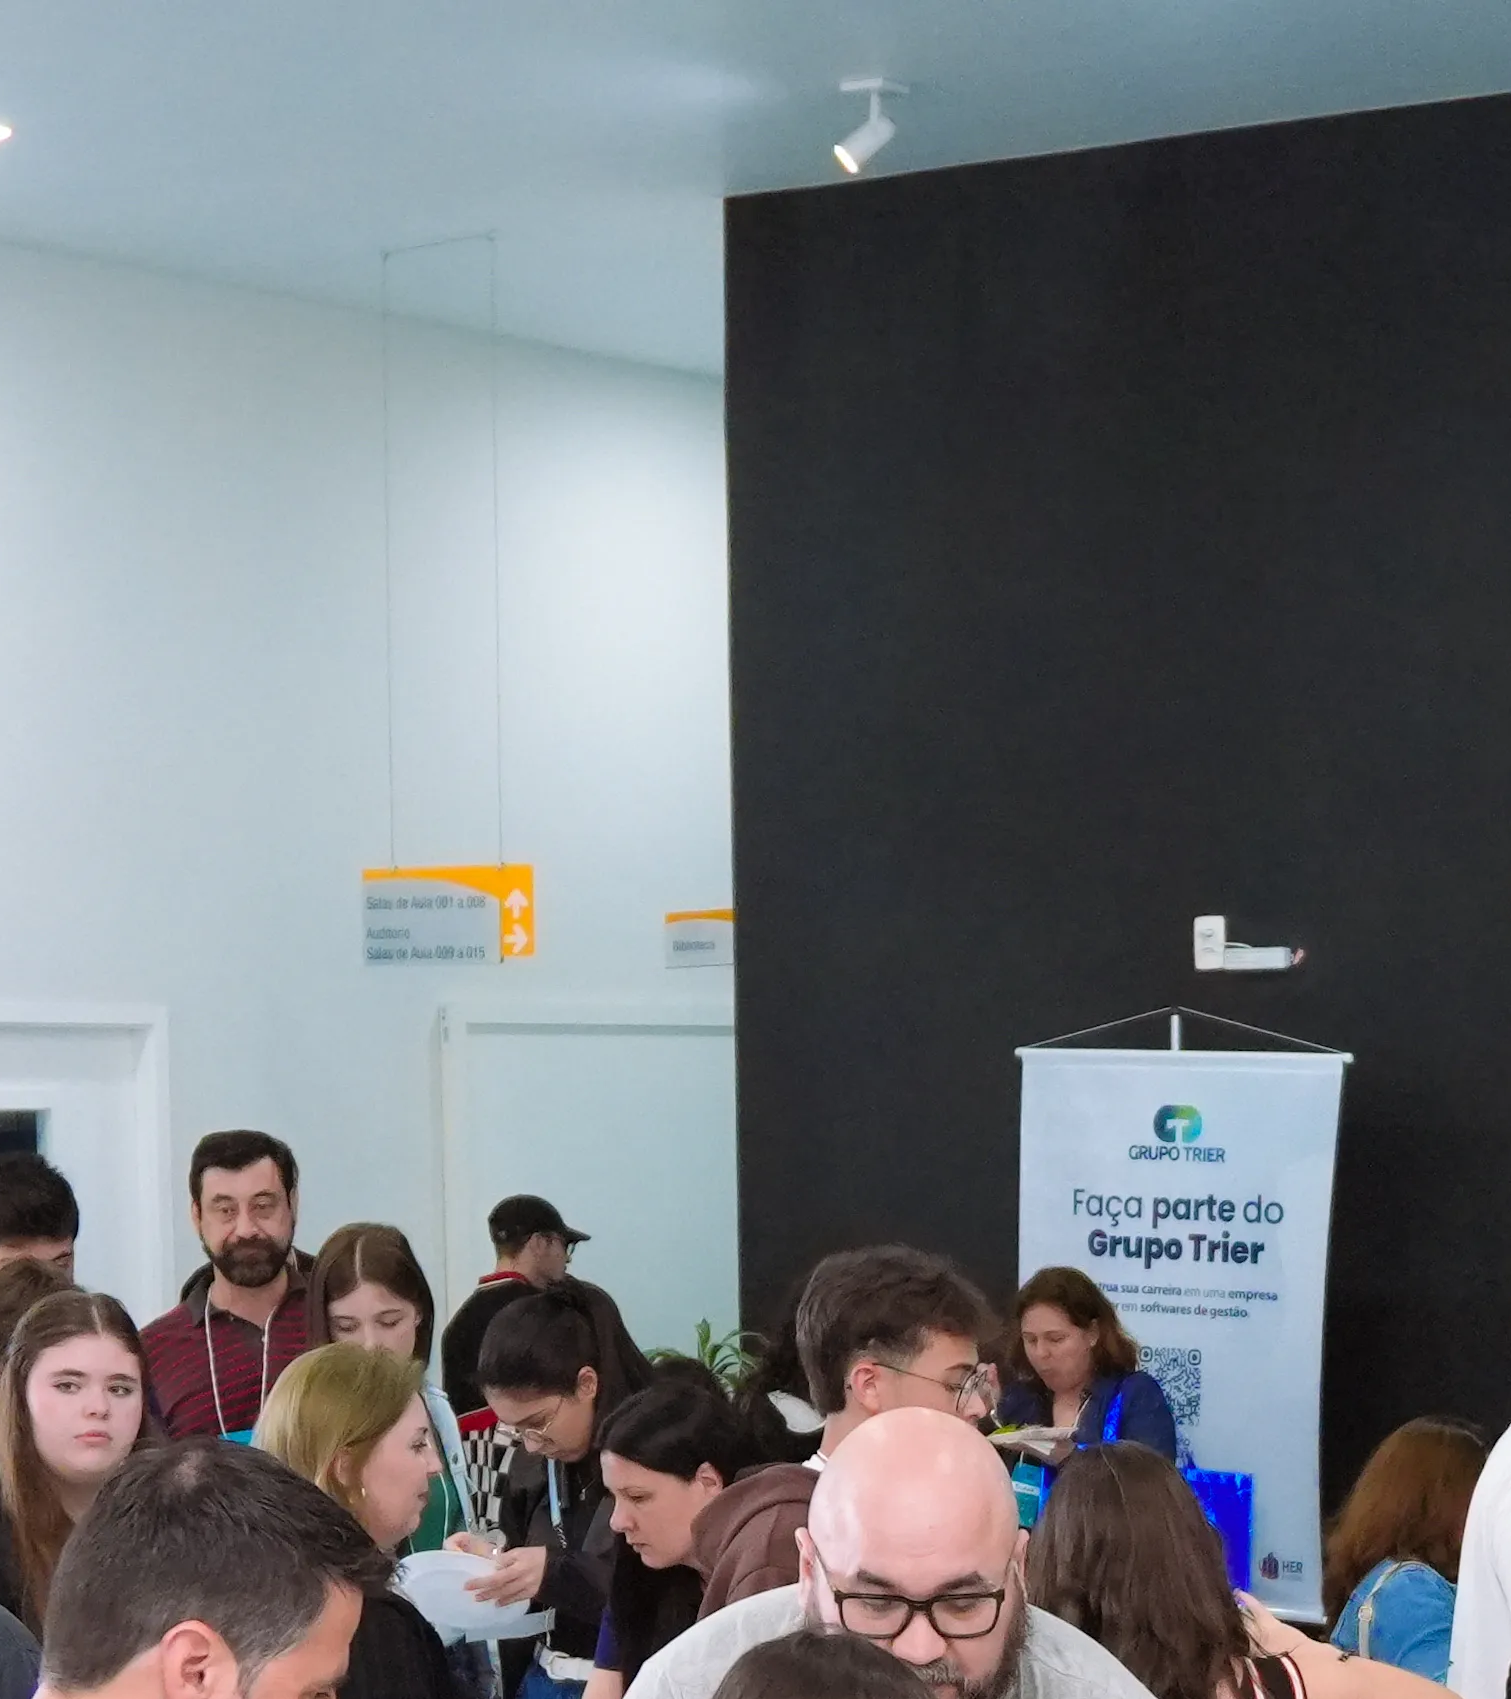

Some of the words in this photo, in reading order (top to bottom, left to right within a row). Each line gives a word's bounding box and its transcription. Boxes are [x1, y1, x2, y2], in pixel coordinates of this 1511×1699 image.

[1128, 1145, 1180, 1161] GRUPO
[1185, 1147, 1226, 1163] TRIER
[1073, 1188, 1143, 1227] Faça
[1152, 1194, 1236, 1229] parte
[1243, 1194, 1284, 1224] do
[1088, 1229, 1183, 1269] Grupo
[1188, 1231, 1265, 1264] Trier
[1228, 1290, 1278, 1302] empresa
